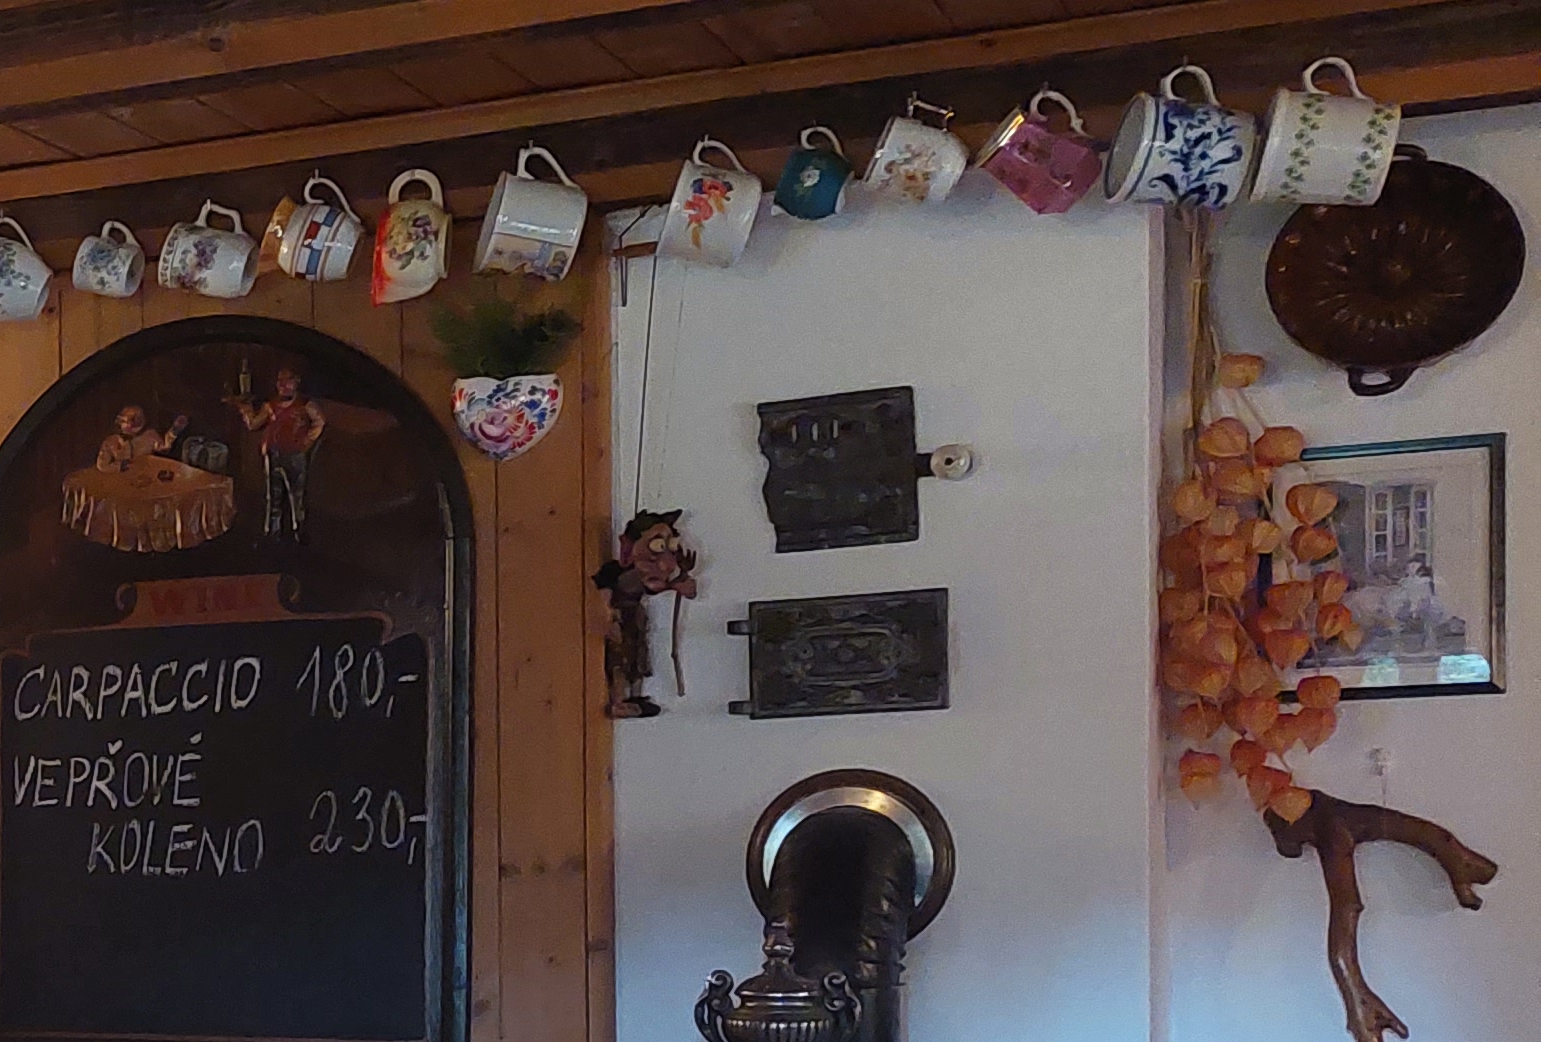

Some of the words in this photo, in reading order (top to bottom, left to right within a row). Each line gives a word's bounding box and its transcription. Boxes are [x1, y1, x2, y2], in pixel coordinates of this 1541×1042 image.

[14, 656, 262, 721] CARPACCIO
[296, 643, 419, 721] 180,-
[13, 731, 203, 810] VEPŘOVÉ
[86, 818, 265, 877] KOLENO
[309, 786, 428, 865] 230,-
